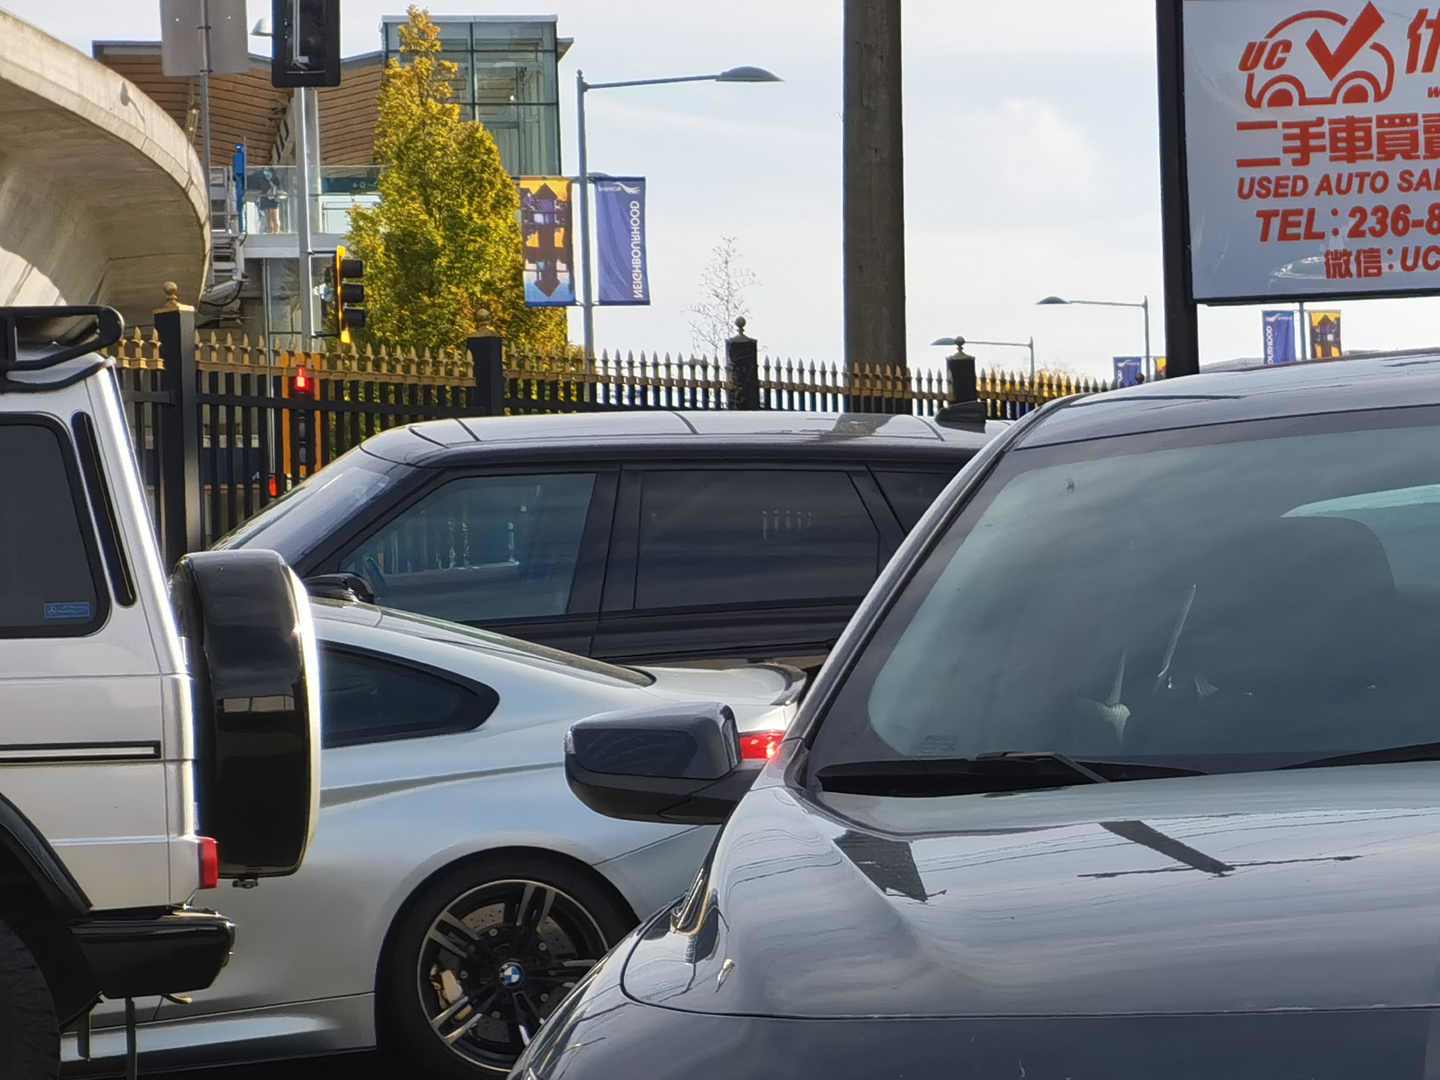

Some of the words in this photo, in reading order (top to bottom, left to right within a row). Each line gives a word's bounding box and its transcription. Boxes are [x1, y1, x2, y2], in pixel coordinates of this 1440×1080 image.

[1238, 39, 1292, 72] UC
[1237, 175, 1309, 200] USED
[1315, 171, 1390, 197] AUTO
